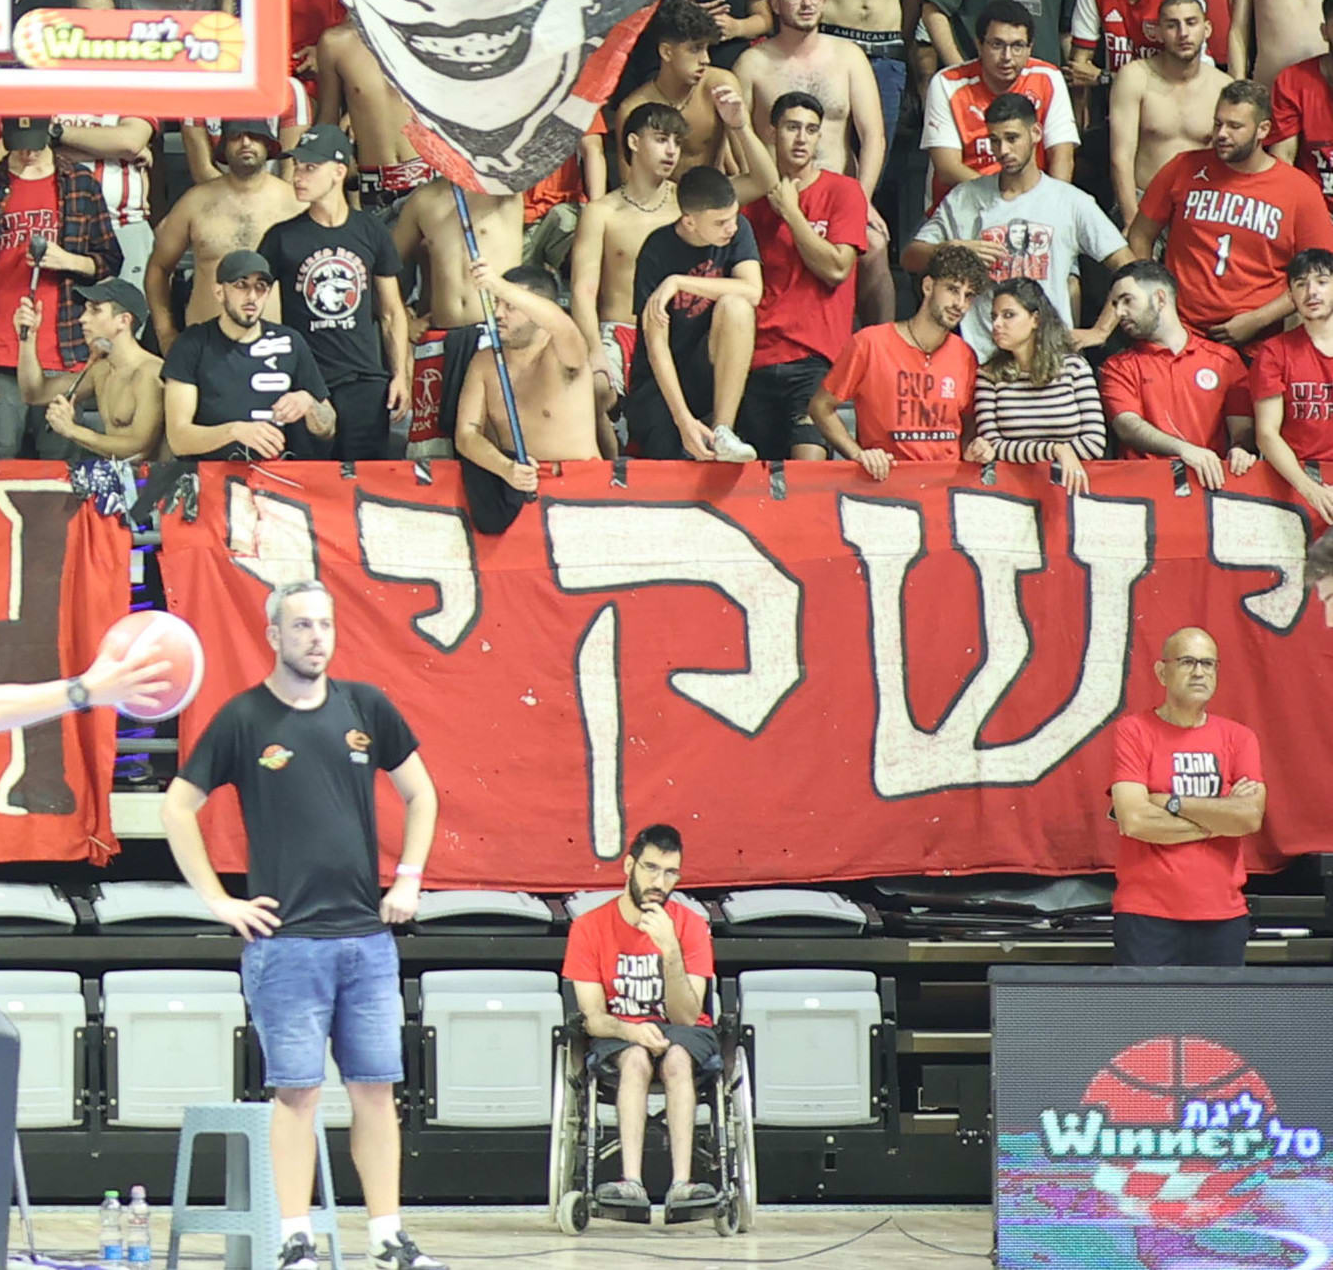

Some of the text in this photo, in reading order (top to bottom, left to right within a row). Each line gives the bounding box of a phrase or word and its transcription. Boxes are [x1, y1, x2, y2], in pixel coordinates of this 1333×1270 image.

[41, 21, 182, 62] Winner
[184, 33, 219, 62] סל
[834, 28, 885, 41] AMERICAN
[1185, 189, 1283, 241] PELICANS
[1215, 234, 1232, 276] 1
[1172, 751, 1218, 773] אהבה
[1172, 773, 1221, 797] לעולם
[616, 953, 661, 976] אהבה
[1183, 1096, 1263, 1129] ליגת
[1040, 1106, 1263, 1159] Winner
[1270, 1118, 1323, 1158] סל
